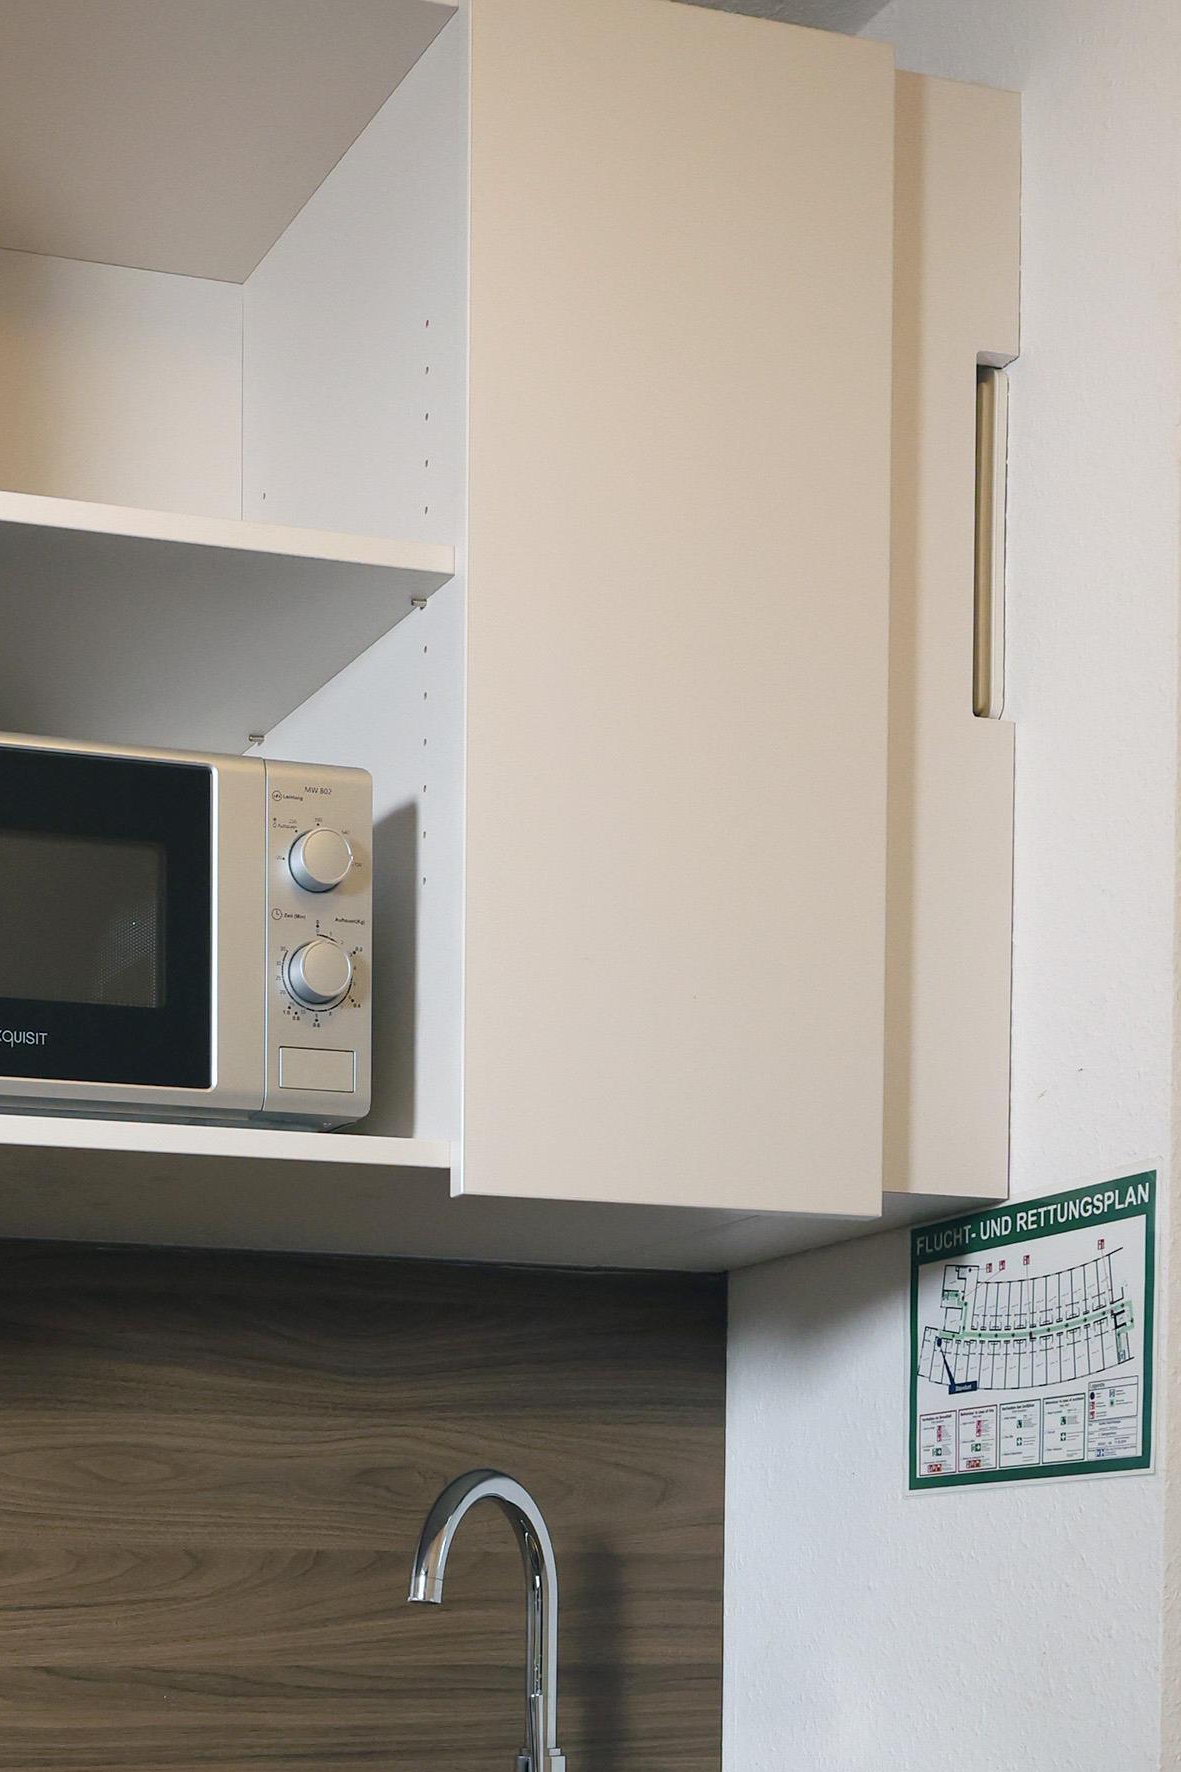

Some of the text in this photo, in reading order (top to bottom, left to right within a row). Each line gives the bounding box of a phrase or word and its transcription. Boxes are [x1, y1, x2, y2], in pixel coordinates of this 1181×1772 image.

[916, 1182, 1150, 1256] FLUCHT- UND RETTUNGSPLAN
